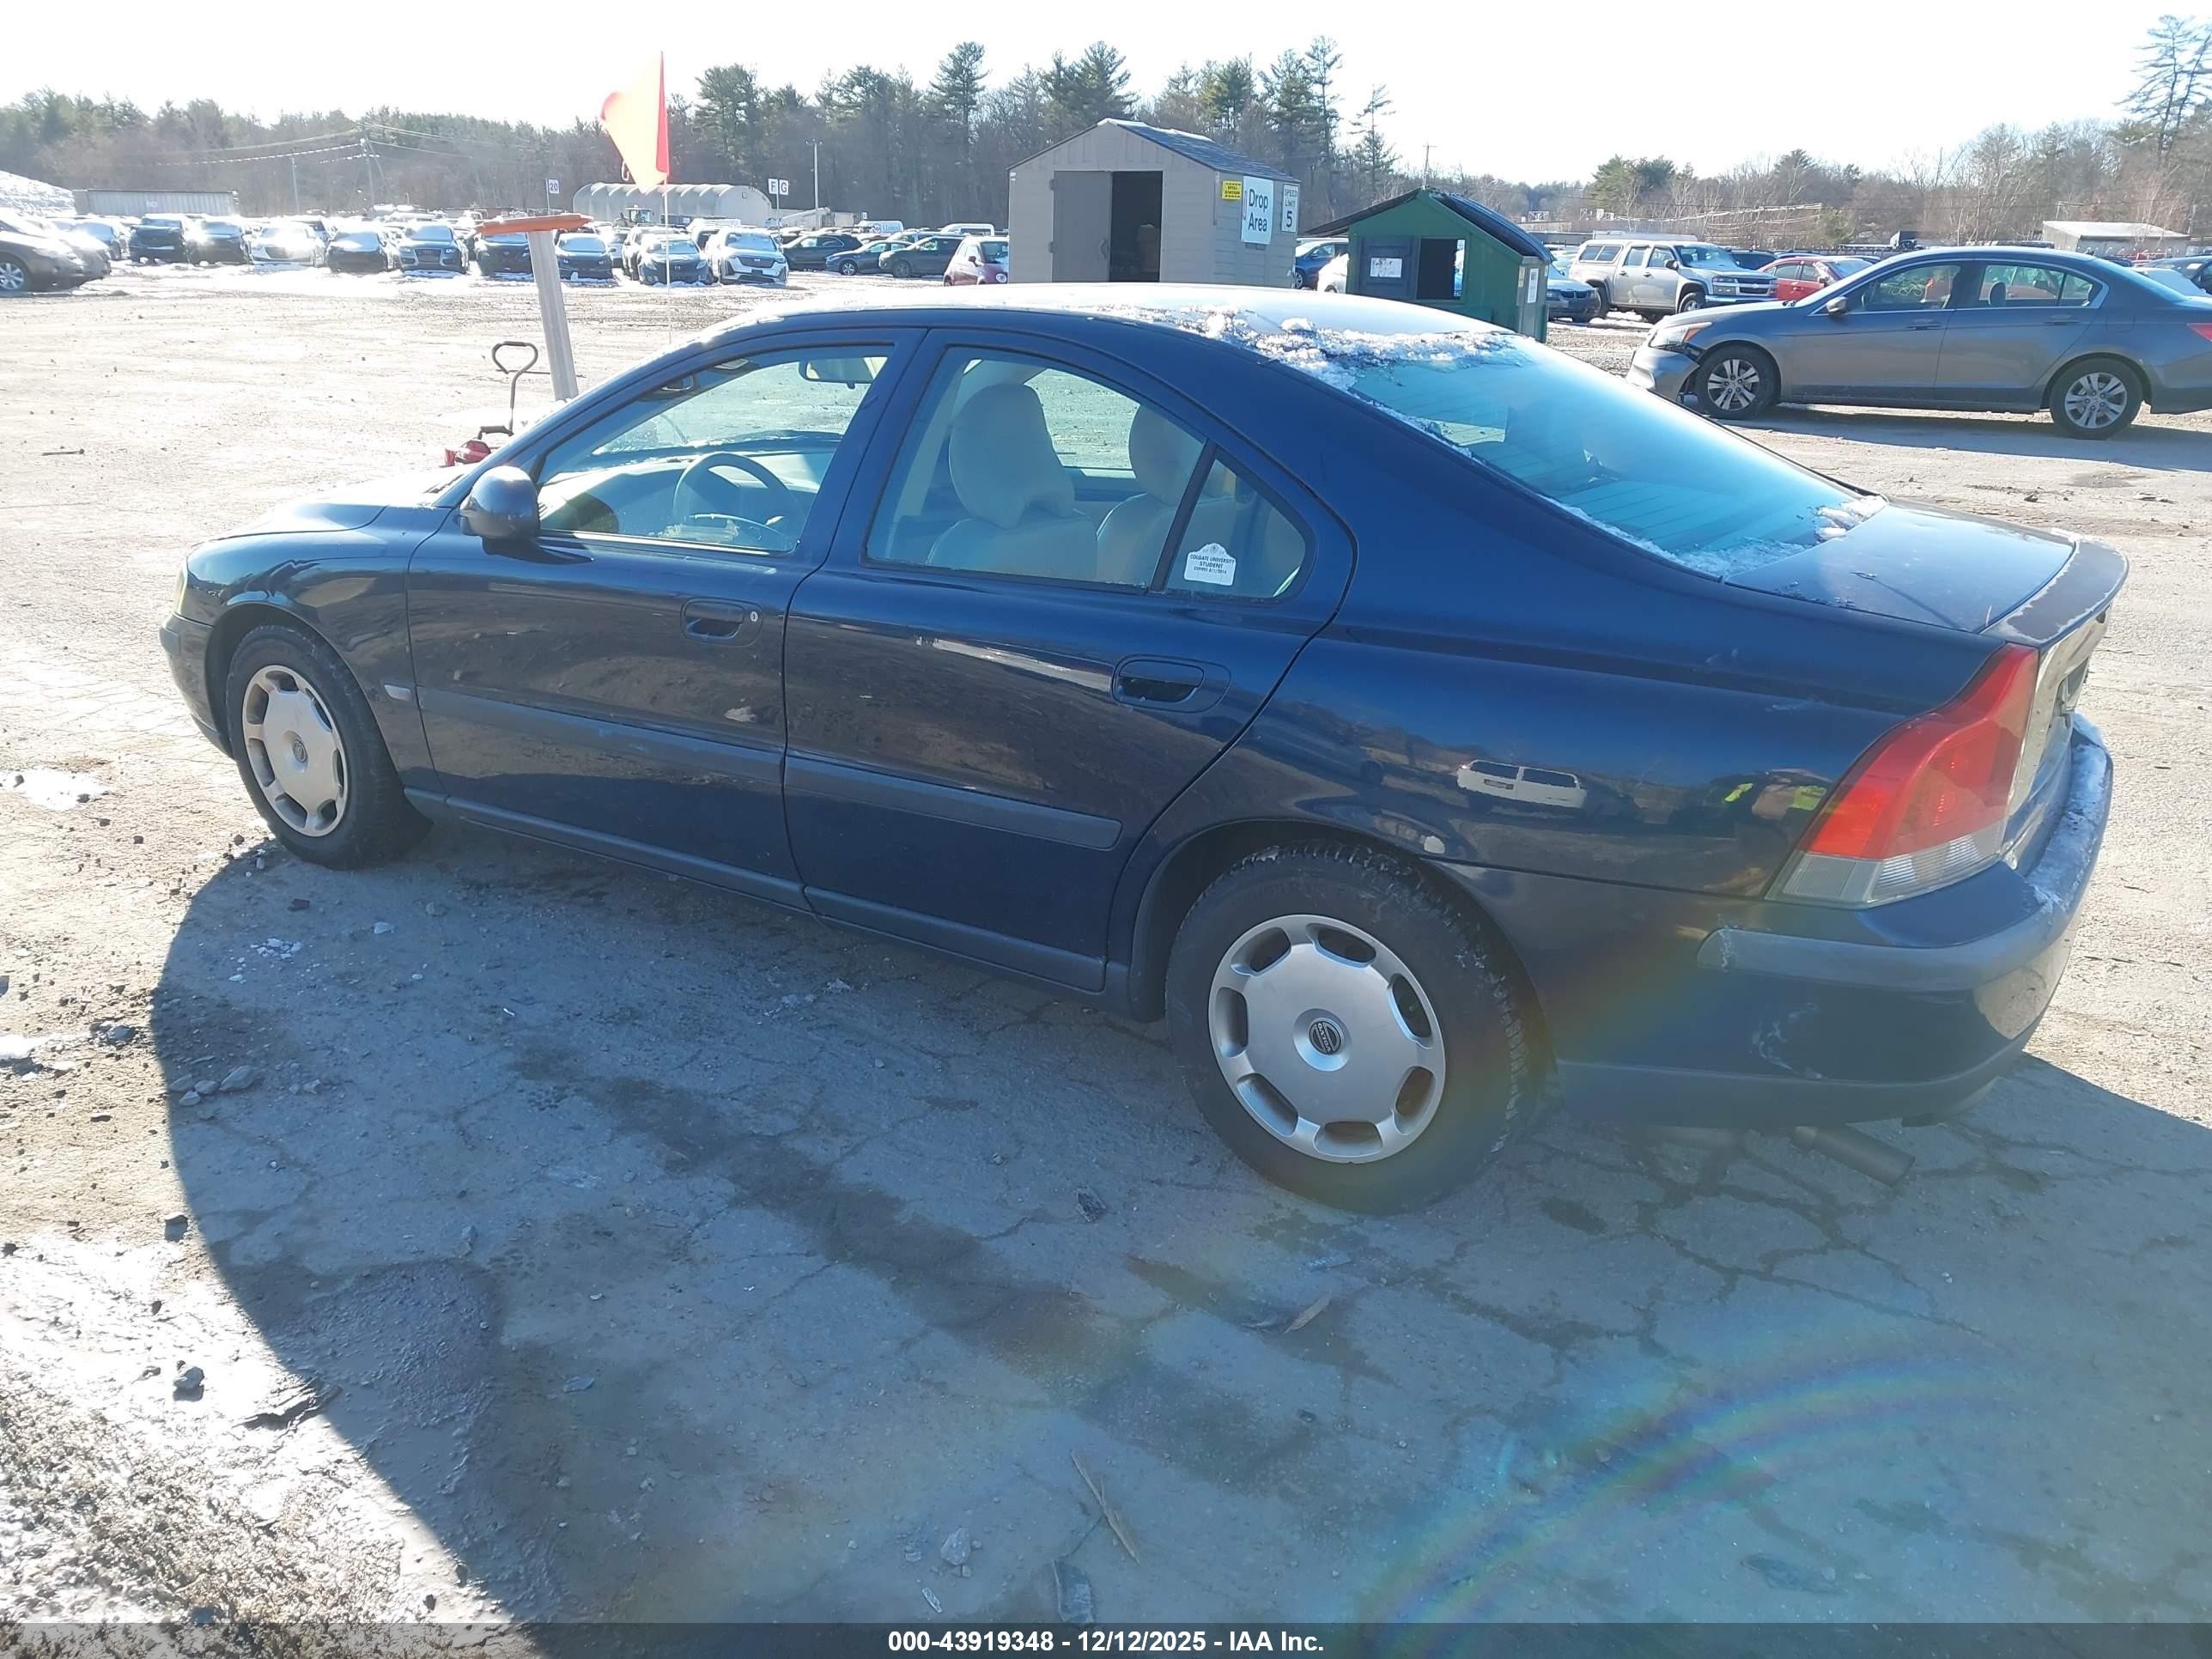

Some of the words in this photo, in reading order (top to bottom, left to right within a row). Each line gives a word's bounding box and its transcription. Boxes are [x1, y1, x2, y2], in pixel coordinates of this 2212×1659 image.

[550, 182, 558, 191] 20
[770, 180, 776, 193] F
[781, 181, 787, 193] G
[1284, 188, 1297, 198] SPEED
[1249, 188, 1269, 212] Drop
[1285, 198, 1296, 207] LIMIT
[1248, 211, 1267, 232] Area
[1285, 210, 1292, 228] 5
[1317, 1022, 1332, 1053] VOLVO
